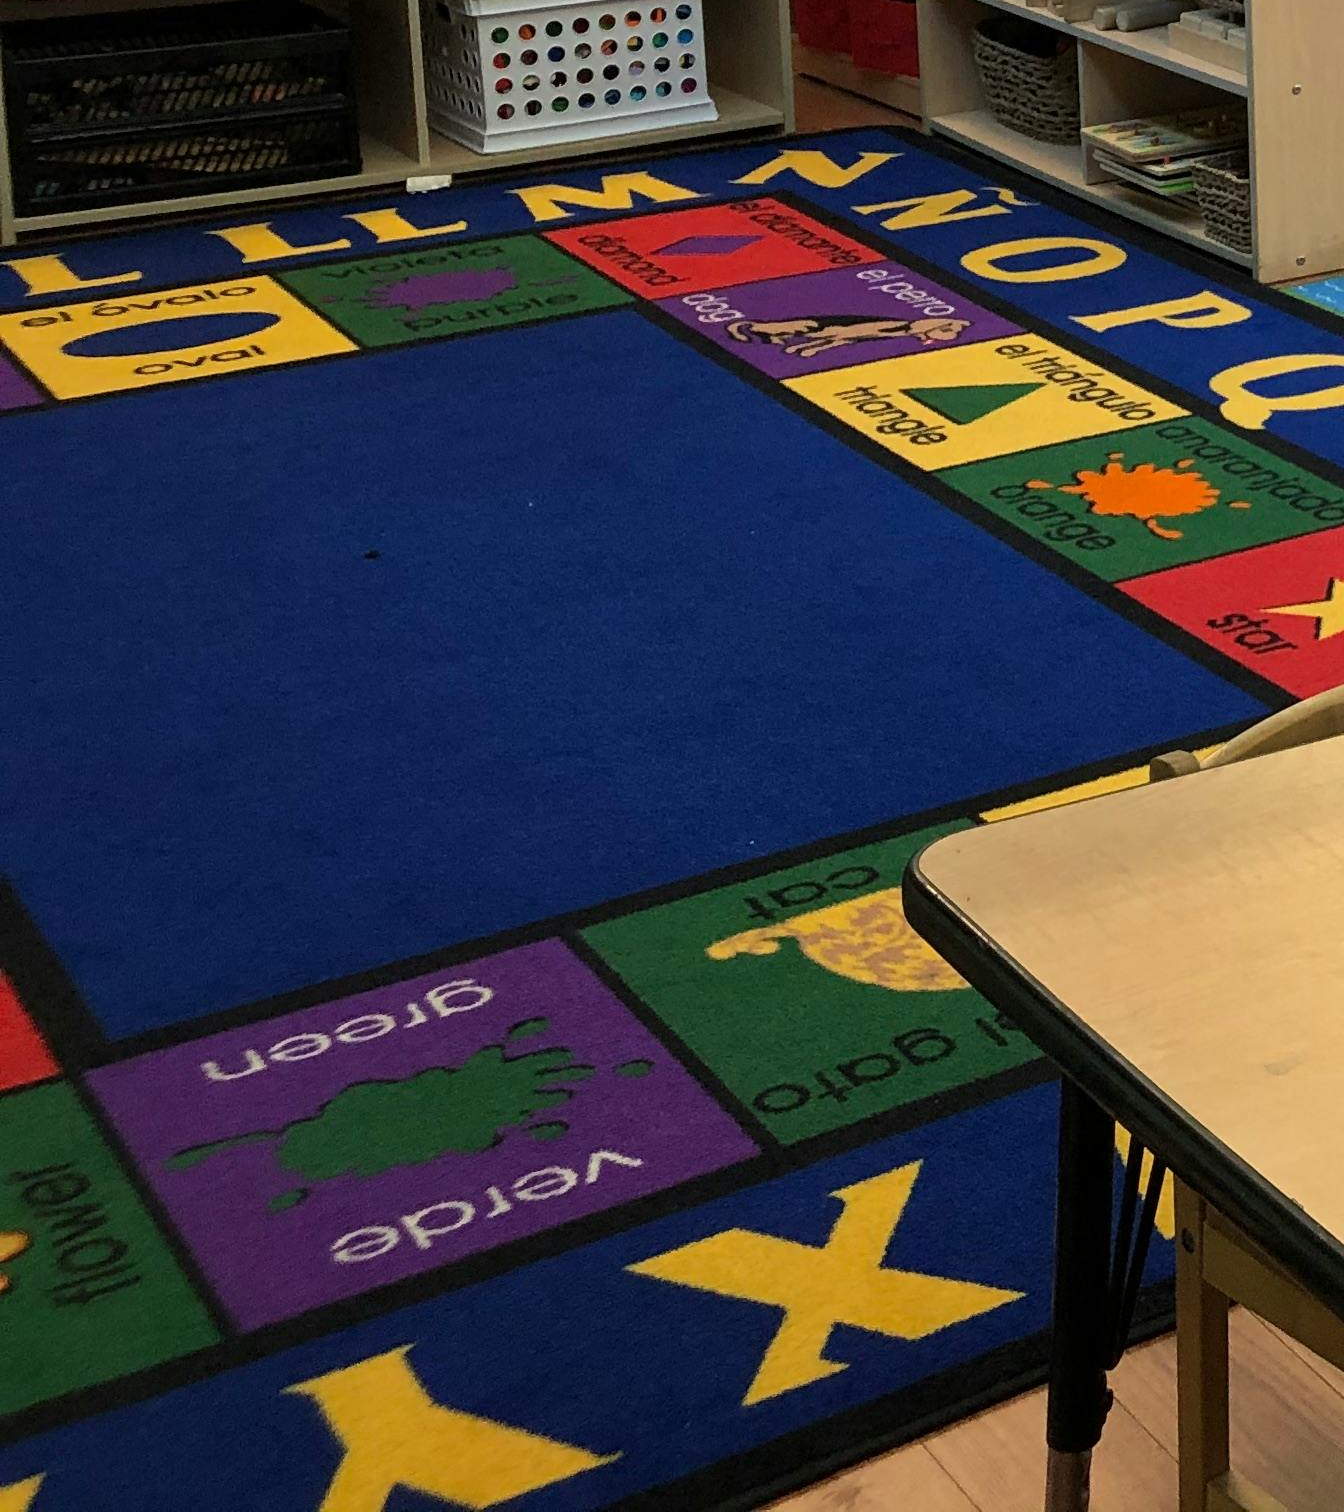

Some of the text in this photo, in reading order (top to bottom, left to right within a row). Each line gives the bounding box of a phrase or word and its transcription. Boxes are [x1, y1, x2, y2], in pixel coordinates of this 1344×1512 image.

[2, 254, 143, 296] L
[504, 171, 712, 222] M
[728, 150, 903, 188] N
[750, 210, 862, 267] diamante
[321, 245, 506, 280] violeta
[578, 234, 696, 287] diamond
[960, 236, 1128, 283] O
[1069, 290, 1253, 332] P
[19, 285, 257, 329] el óvalo
[402, 293, 579, 331] purple
[681, 292, 748, 324] dog
[856, 268, 955, 317] el perro
[133, 344, 267, 376] oval
[994, 344, 1155, 422] el triángulo
[834, 385, 947, 445] triangle
[990, 484, 1116, 550] orange
[1206, 612, 1298, 654] star
[744, 865, 879, 920] cat
[200, 978, 494, 1081] green
[752, 1028, 957, 1114] gato
[9, 1162, 141, 1307] flower
[330, 1148, 643, 1264] verde
[625, 1160, 1026, 1405] X
[281, 1343, 624, 1512] Y
